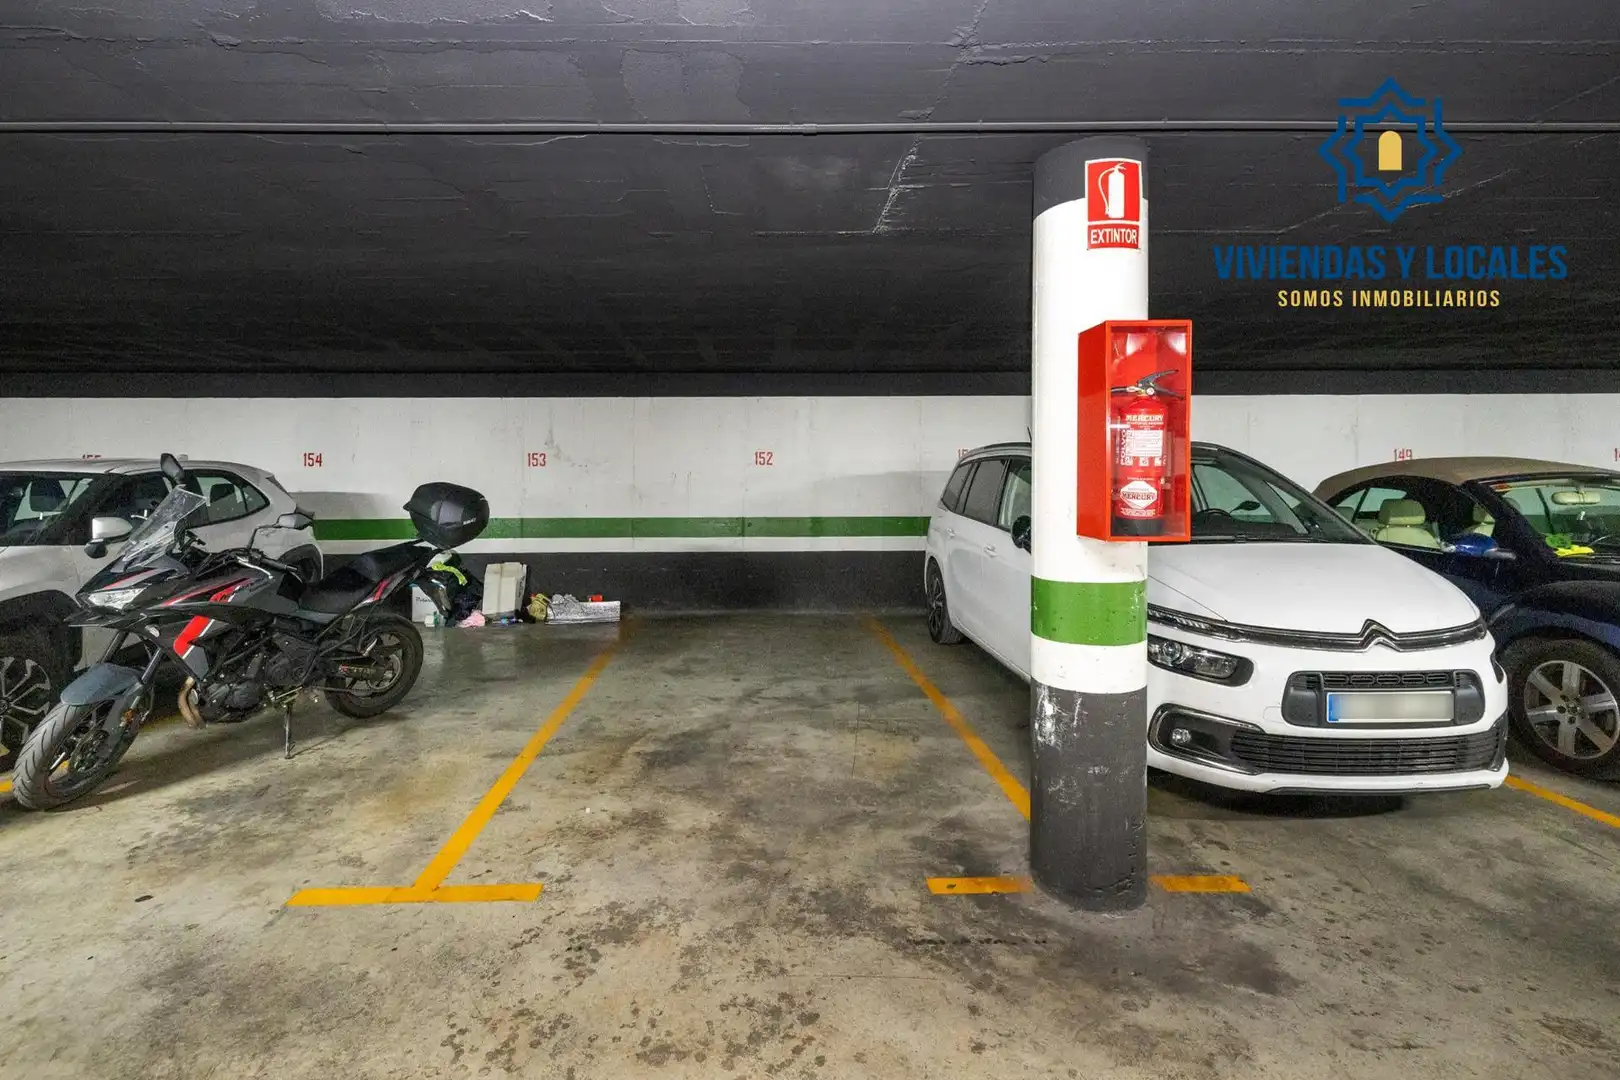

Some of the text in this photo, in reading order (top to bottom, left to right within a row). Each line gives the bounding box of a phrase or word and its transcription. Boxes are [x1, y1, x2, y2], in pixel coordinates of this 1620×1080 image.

[1090, 228, 1138, 245] EXTINTOR
[1125, 414, 1164, 422] MERCURY
[303, 452, 323, 468] 154
[527, 452, 547, 467] 153
[754, 451, 774, 466] 152
[1393, 448, 1413, 462] 149
[1121, 490, 1156, 501] MERCURY
